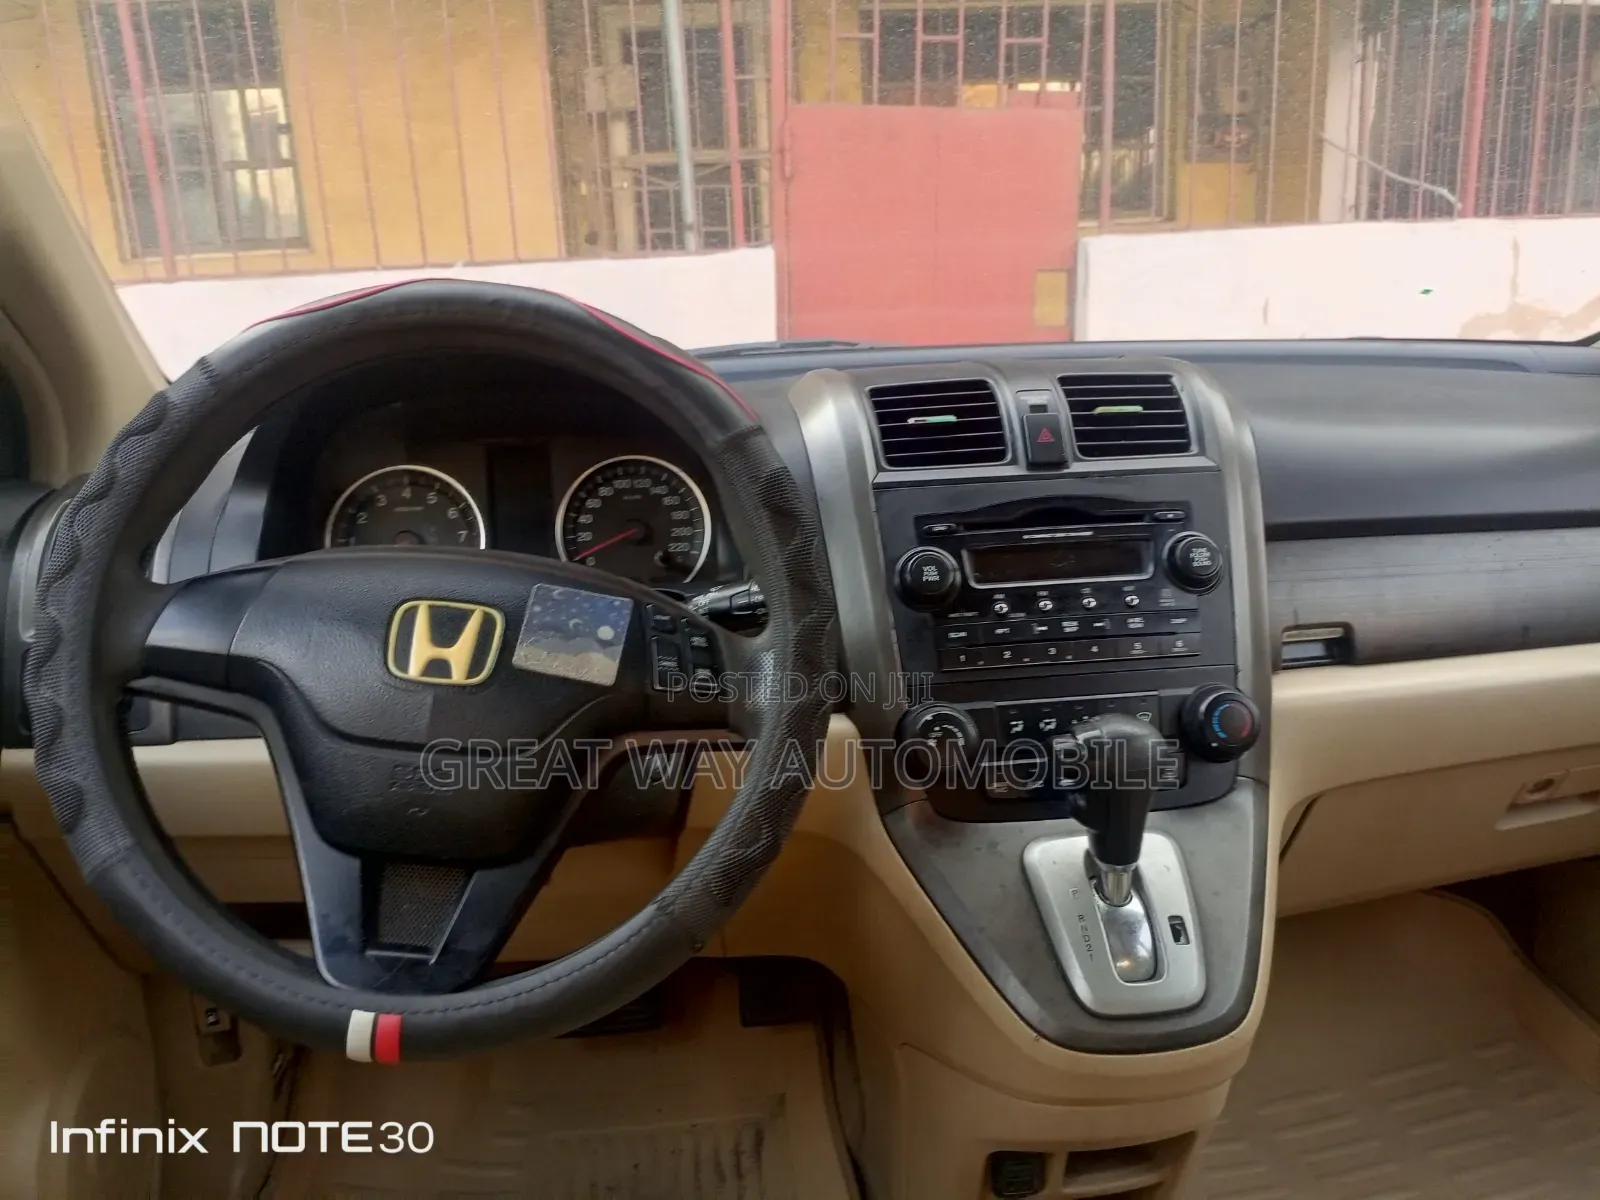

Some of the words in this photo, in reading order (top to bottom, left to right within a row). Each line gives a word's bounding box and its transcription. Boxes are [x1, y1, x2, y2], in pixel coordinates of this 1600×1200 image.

[376, 494, 387, 506] 3
[426, 492, 438, 504] 5
[356, 512, 368, 524] 2
[447, 508, 459, 519] 6
[457, 530, 469, 542] 7
[576, 532, 593, 541] 20
